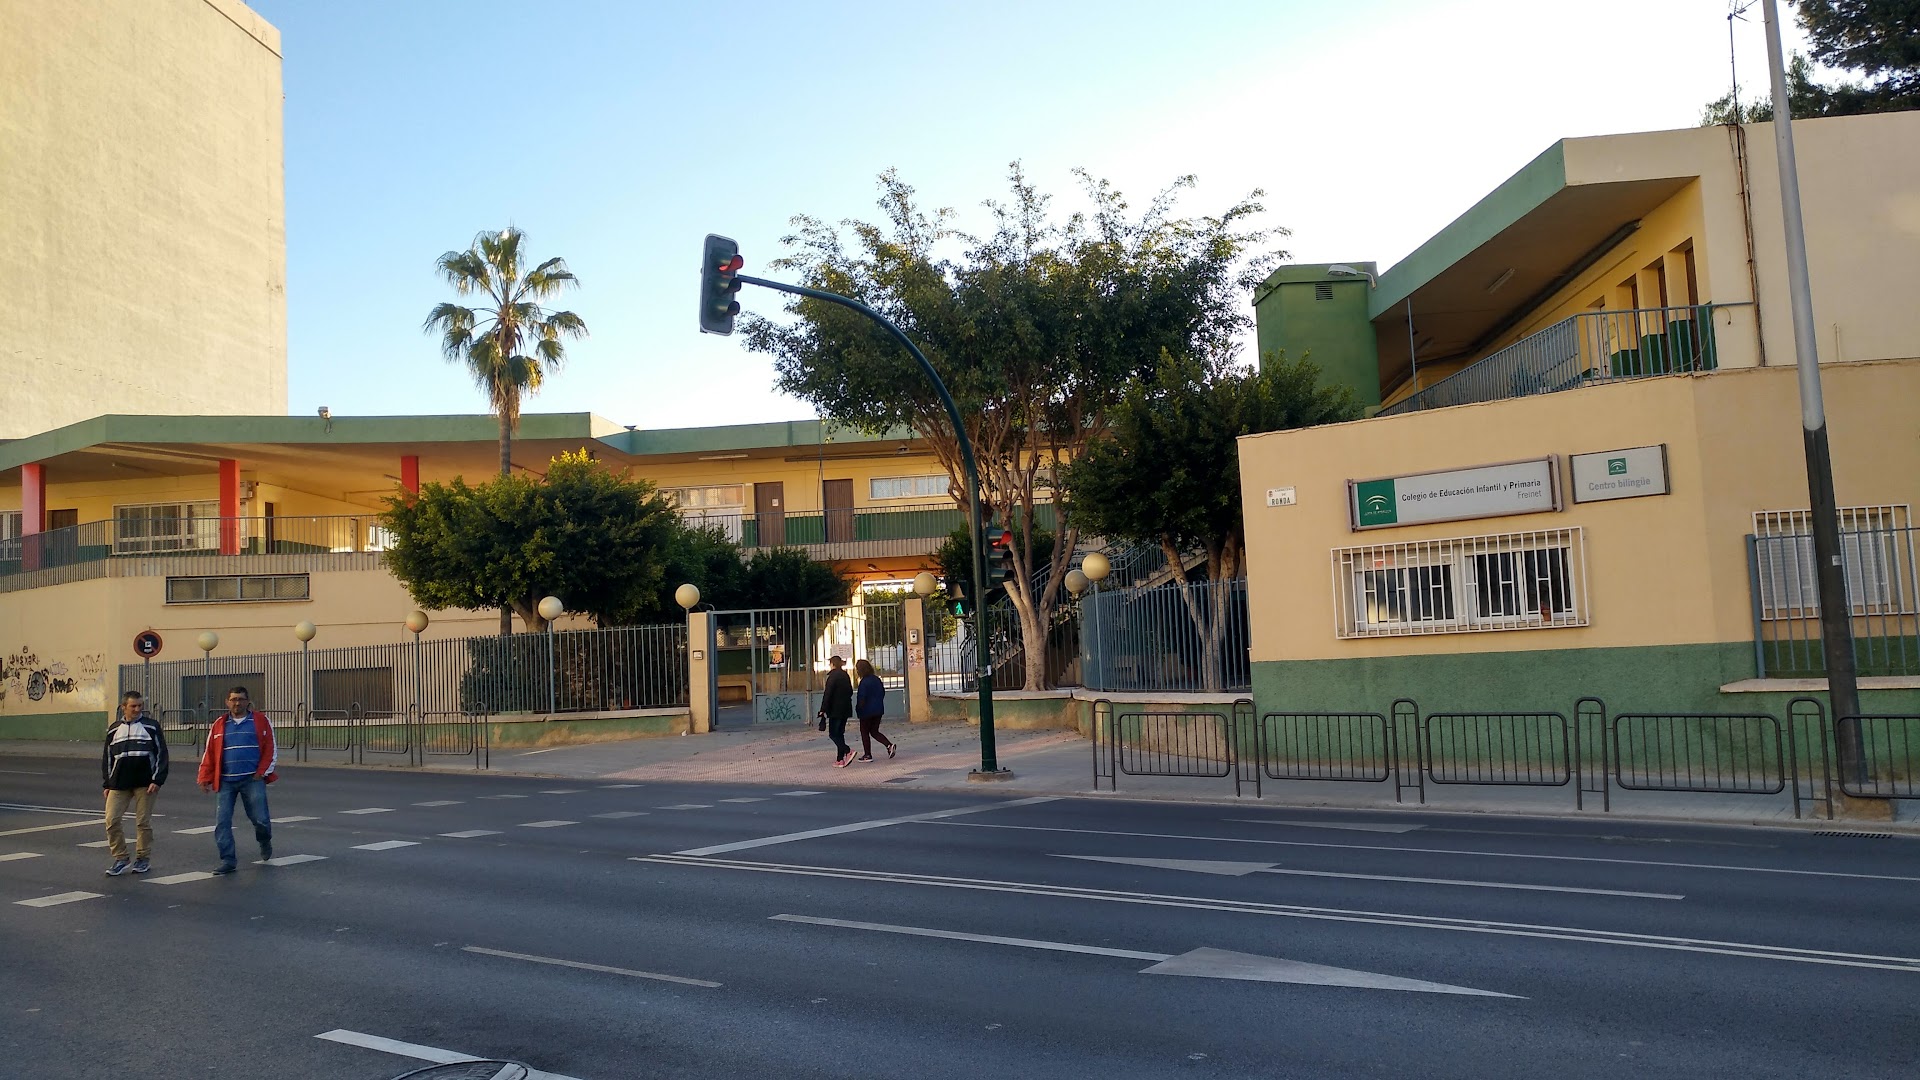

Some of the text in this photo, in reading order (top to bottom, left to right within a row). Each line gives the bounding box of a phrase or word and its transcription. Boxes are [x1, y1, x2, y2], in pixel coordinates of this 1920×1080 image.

[1588, 477, 1651, 491] Centro bilingüe
[1401, 479, 1541, 502] Colegio de Educación Infantil y Primaria
[1517, 490, 1542, 499] Freinet
[1271, 497, 1291, 505] RONDA
